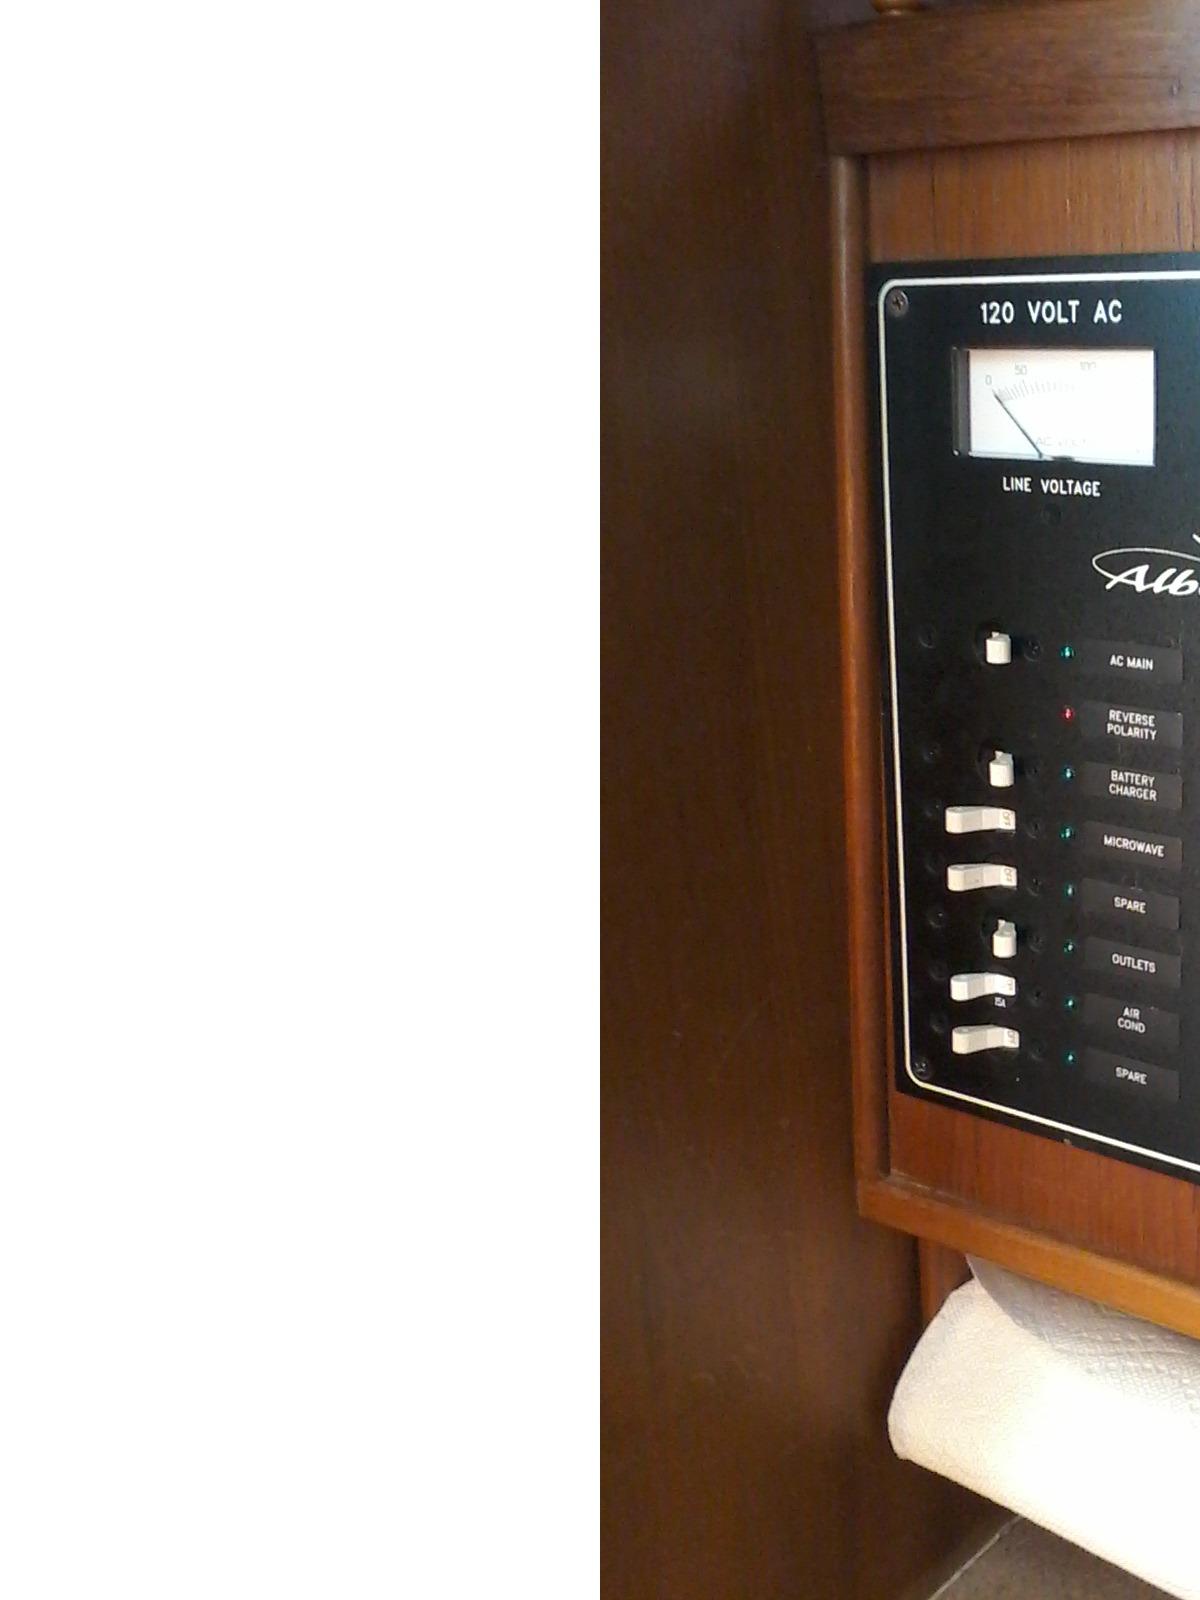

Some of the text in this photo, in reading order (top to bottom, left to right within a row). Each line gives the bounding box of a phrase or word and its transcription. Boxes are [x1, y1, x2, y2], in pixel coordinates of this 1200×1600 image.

[980, 299, 1122, 325] 120 VOLT AC
[1002, 476, 1101, 497] LINE VOLTAGE
[1109, 654, 1154, 671] AC MAIN
[1108, 709, 1156, 727] REVERSE
[1106, 722, 1157, 741] POLARITY
[1110, 769, 1155, 786] BATTERY
[1108, 783, 1157, 802] CHARGER
[1103, 834, 1165, 858] MICROWAVE
[1114, 896, 1147, 914] SPARE
[1111, 953, 1156, 974] OUTLETS
[1122, 1006, 1141, 1021] AIR
[1117, 1016, 1147, 1034] COND
[1115, 1066, 1148, 1085] SPARE
